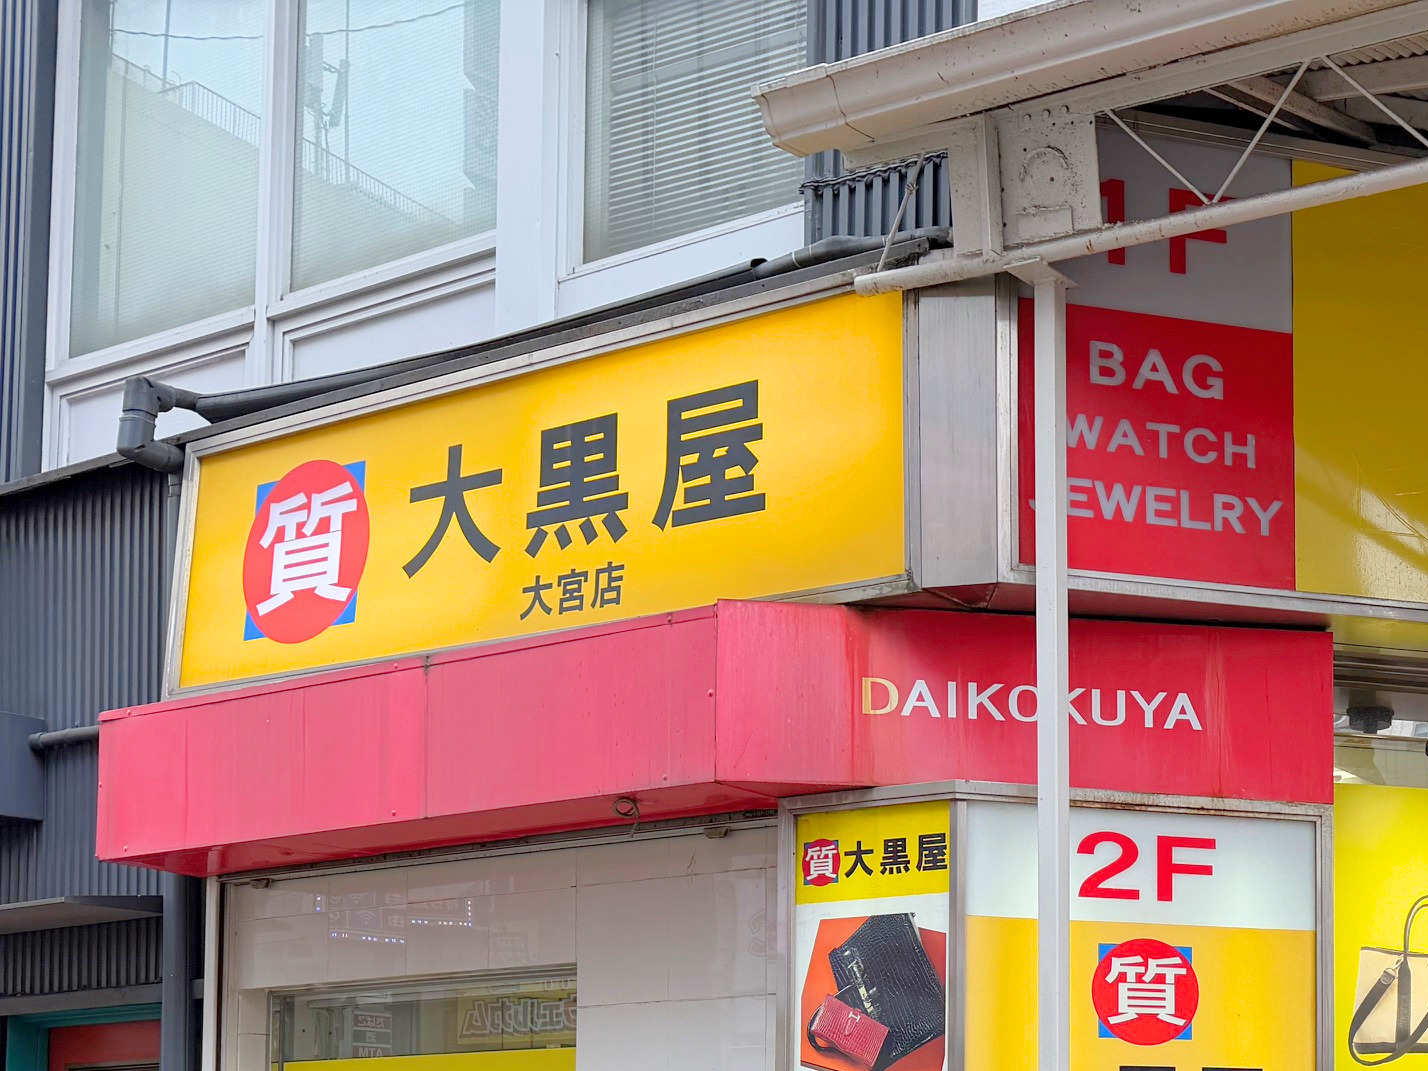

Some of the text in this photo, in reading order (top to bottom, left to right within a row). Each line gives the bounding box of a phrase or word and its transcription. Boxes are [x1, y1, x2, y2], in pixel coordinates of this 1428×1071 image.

[1089, 340, 1224, 400] BAG
[1066, 413, 1256, 469] WATCH
[255, 379, 766, 616] 質 大黒屋
[1029, 476, 1283, 537] EWELRY
[519, 561, 626, 621] 大宮店
[804, 833, 948, 882] 質 大黒屋
[1076, 831, 1216, 902] 2F
[1105, 955, 1187, 1027] 質
